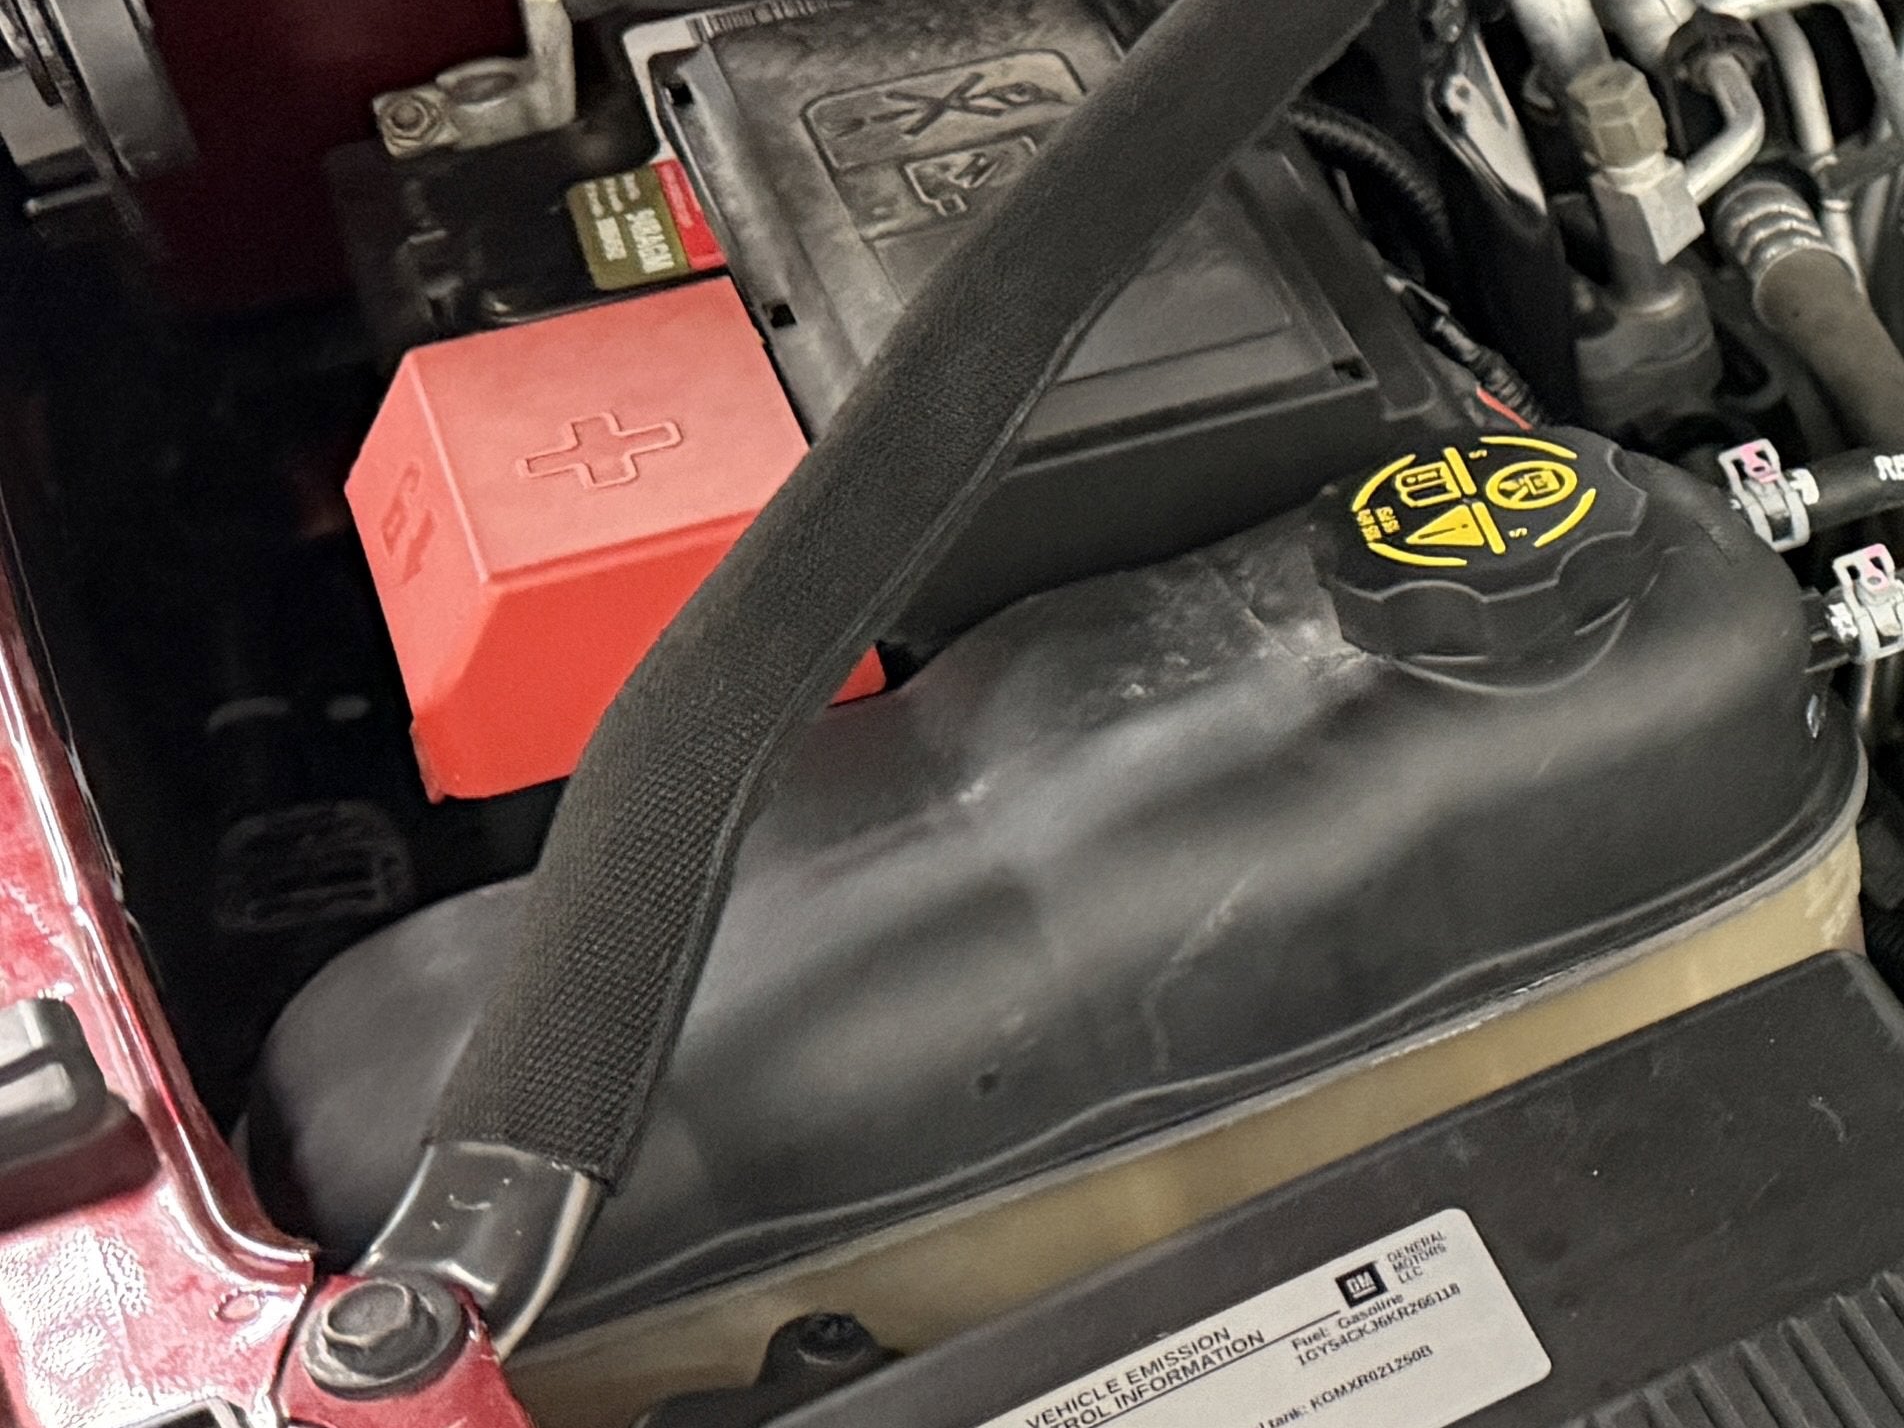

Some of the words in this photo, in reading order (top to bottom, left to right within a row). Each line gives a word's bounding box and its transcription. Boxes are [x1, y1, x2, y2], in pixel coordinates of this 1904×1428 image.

[1386, 1230, 1446, 1262] GENERAL
[1391, 1243, 1446, 1273] MOTORS
[1397, 1265, 1423, 1284] LLC
[1290, 1327, 1330, 1351] Fuel:
[1336, 1293, 1404, 1330] Gasoline
[1113, 1329, 1265, 1410] INFORMATION
[1124, 1326, 1231, 1386] EMISSION
